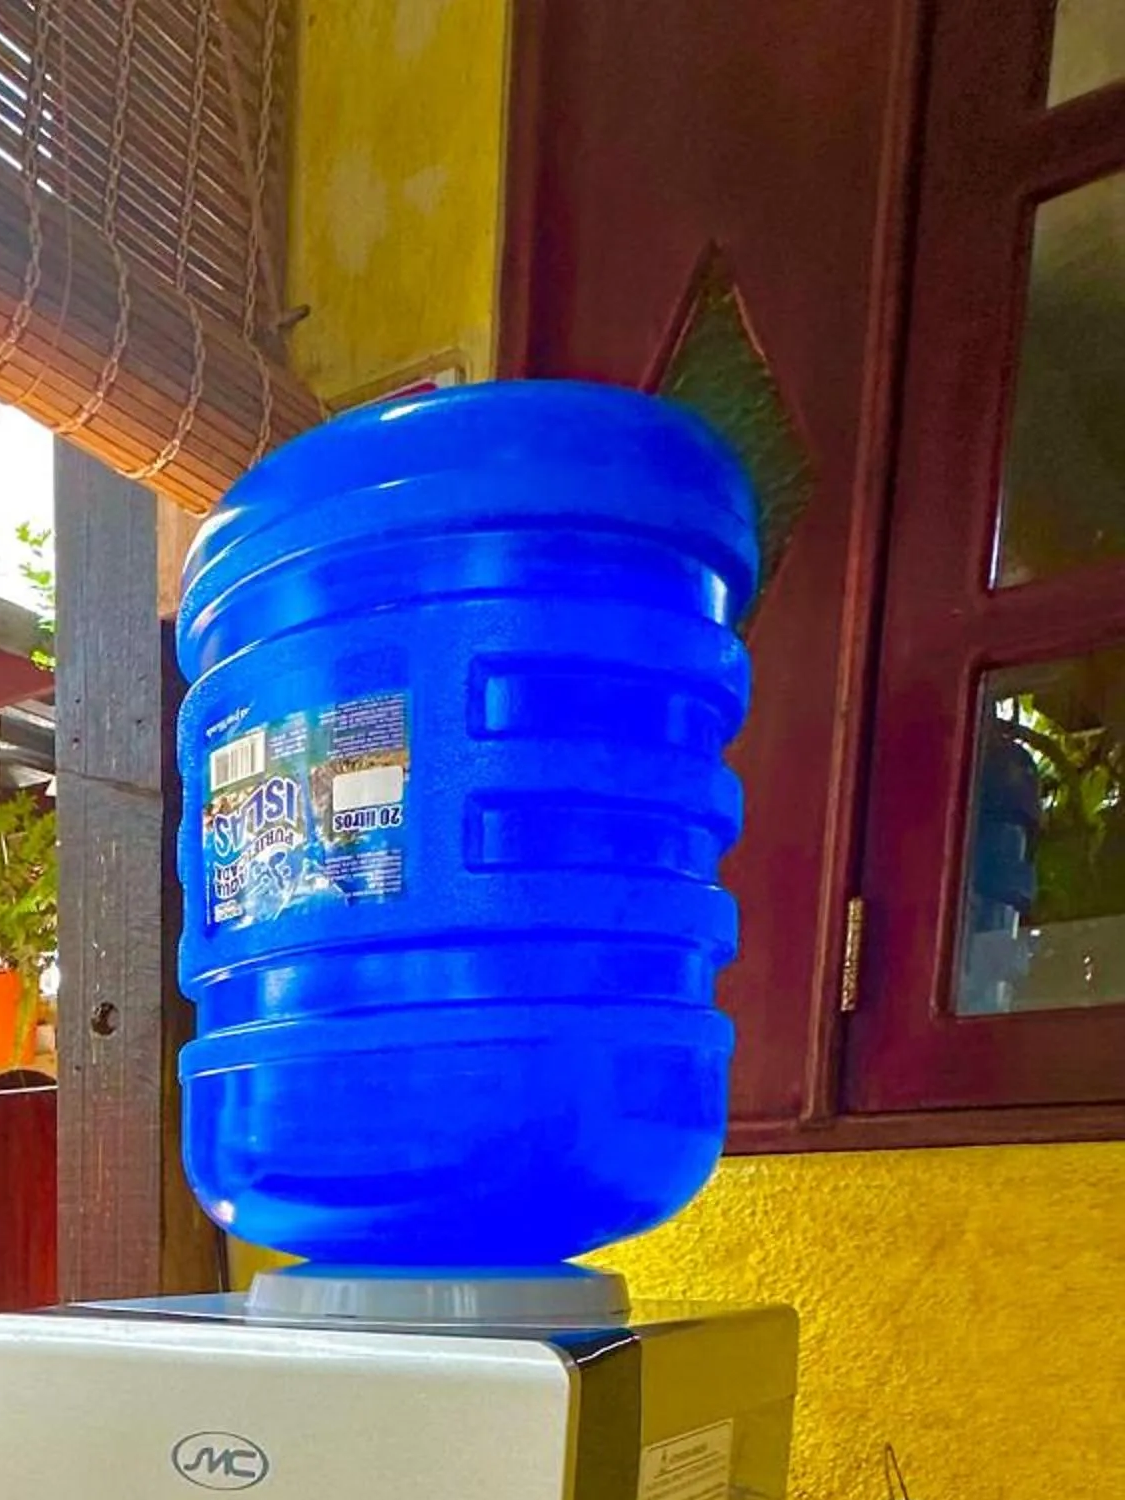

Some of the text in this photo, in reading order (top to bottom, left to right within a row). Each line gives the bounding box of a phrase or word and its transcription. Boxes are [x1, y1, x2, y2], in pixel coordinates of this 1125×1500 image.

[215, 777, 295, 857] ISLAS
[333, 806, 401, 832] 20 litros
